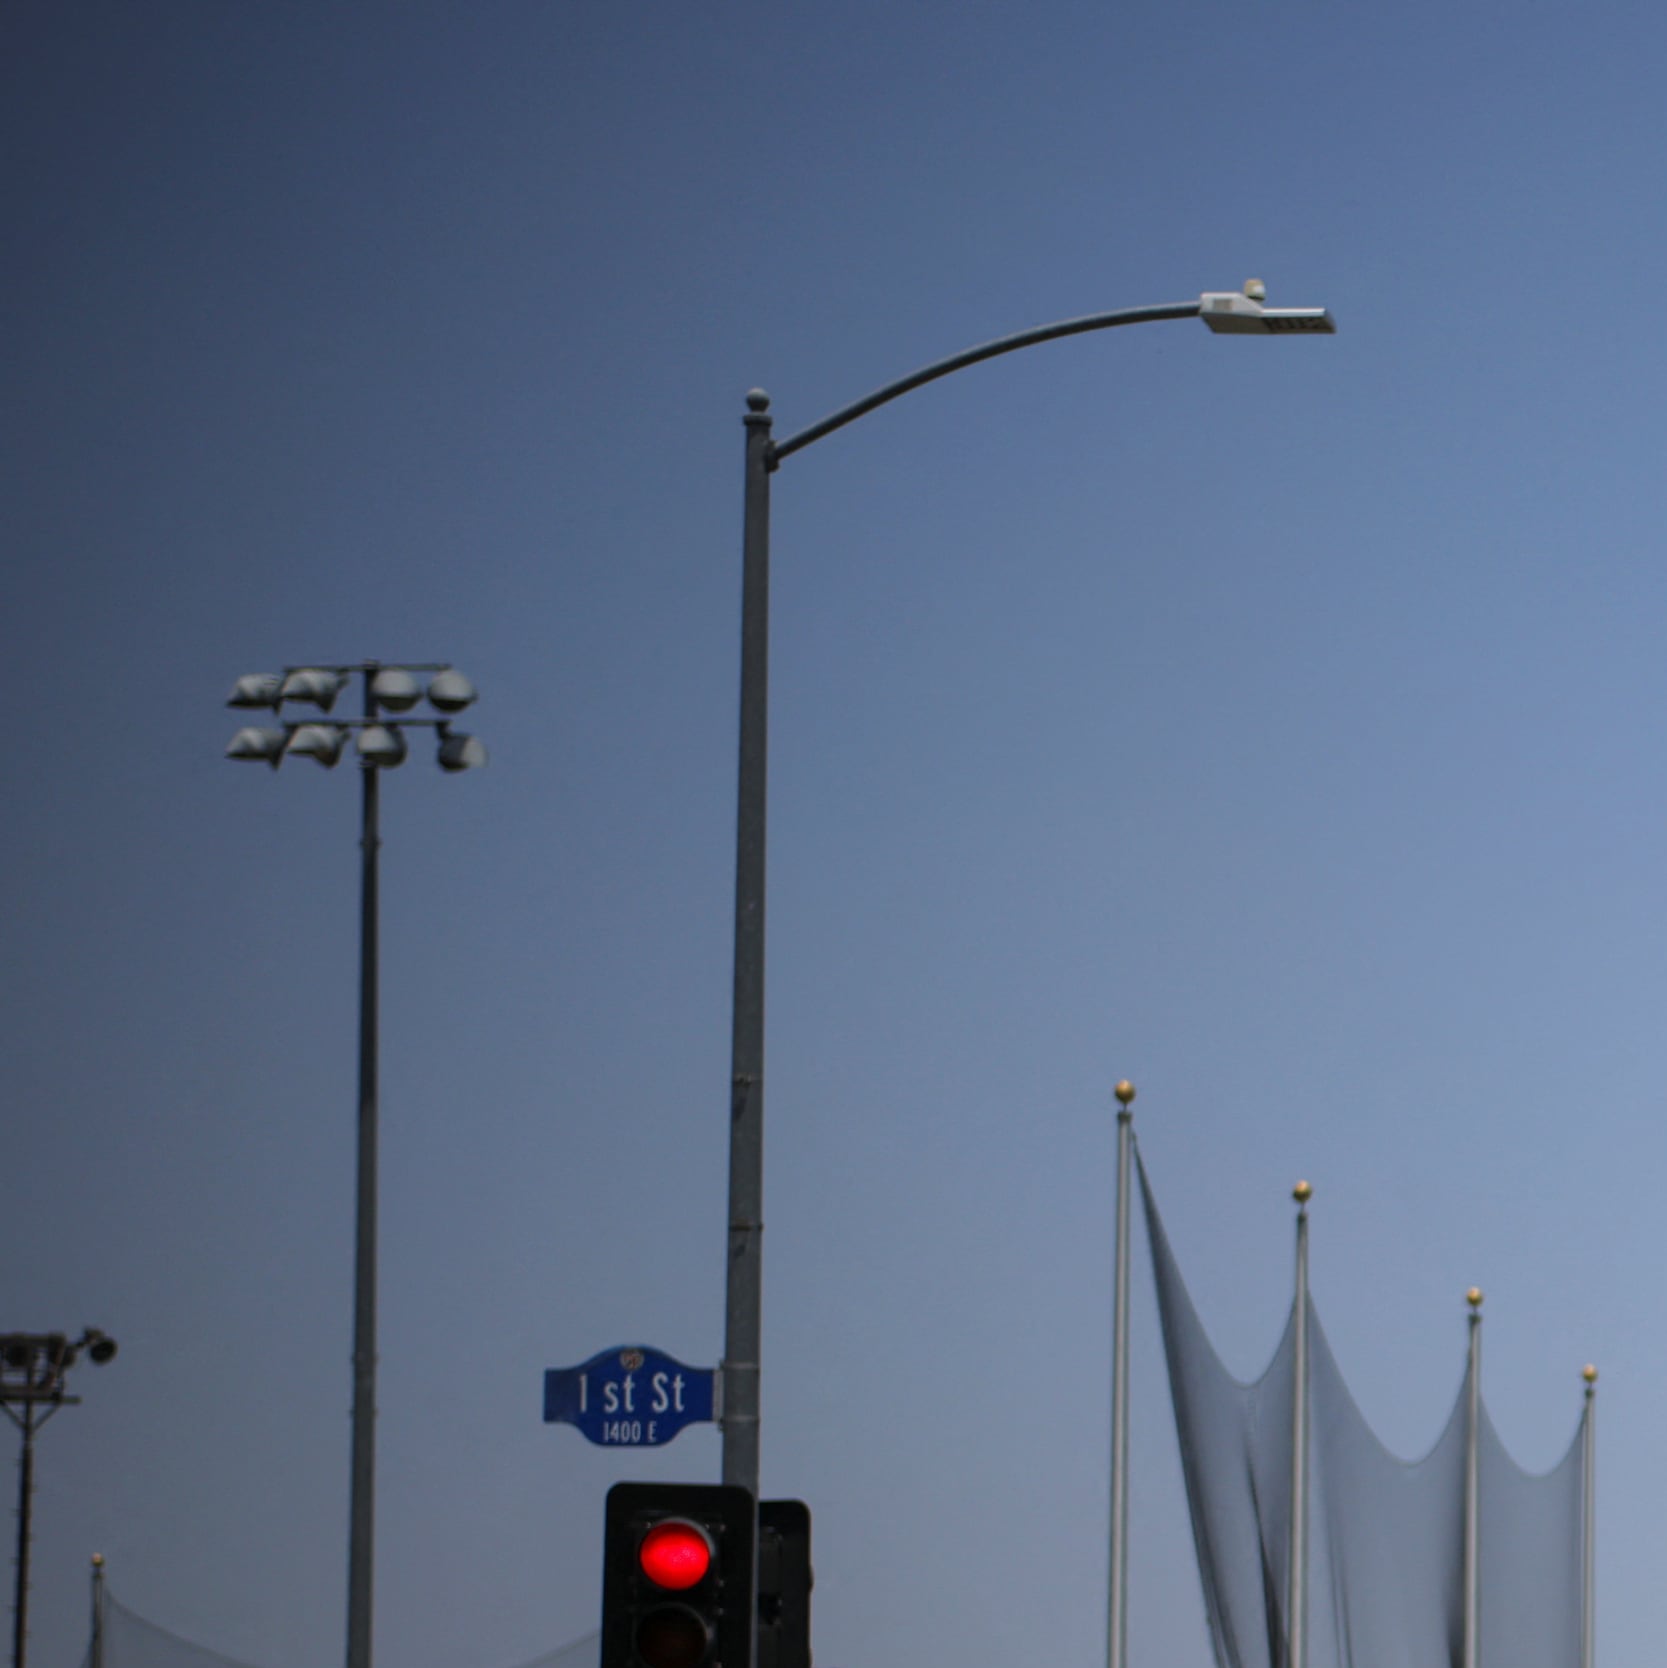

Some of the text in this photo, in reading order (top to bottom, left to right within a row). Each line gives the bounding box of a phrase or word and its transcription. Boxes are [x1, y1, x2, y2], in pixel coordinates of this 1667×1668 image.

[651, 1372, 685, 1413] St
[604, 1420, 657, 1443] 1400 E
